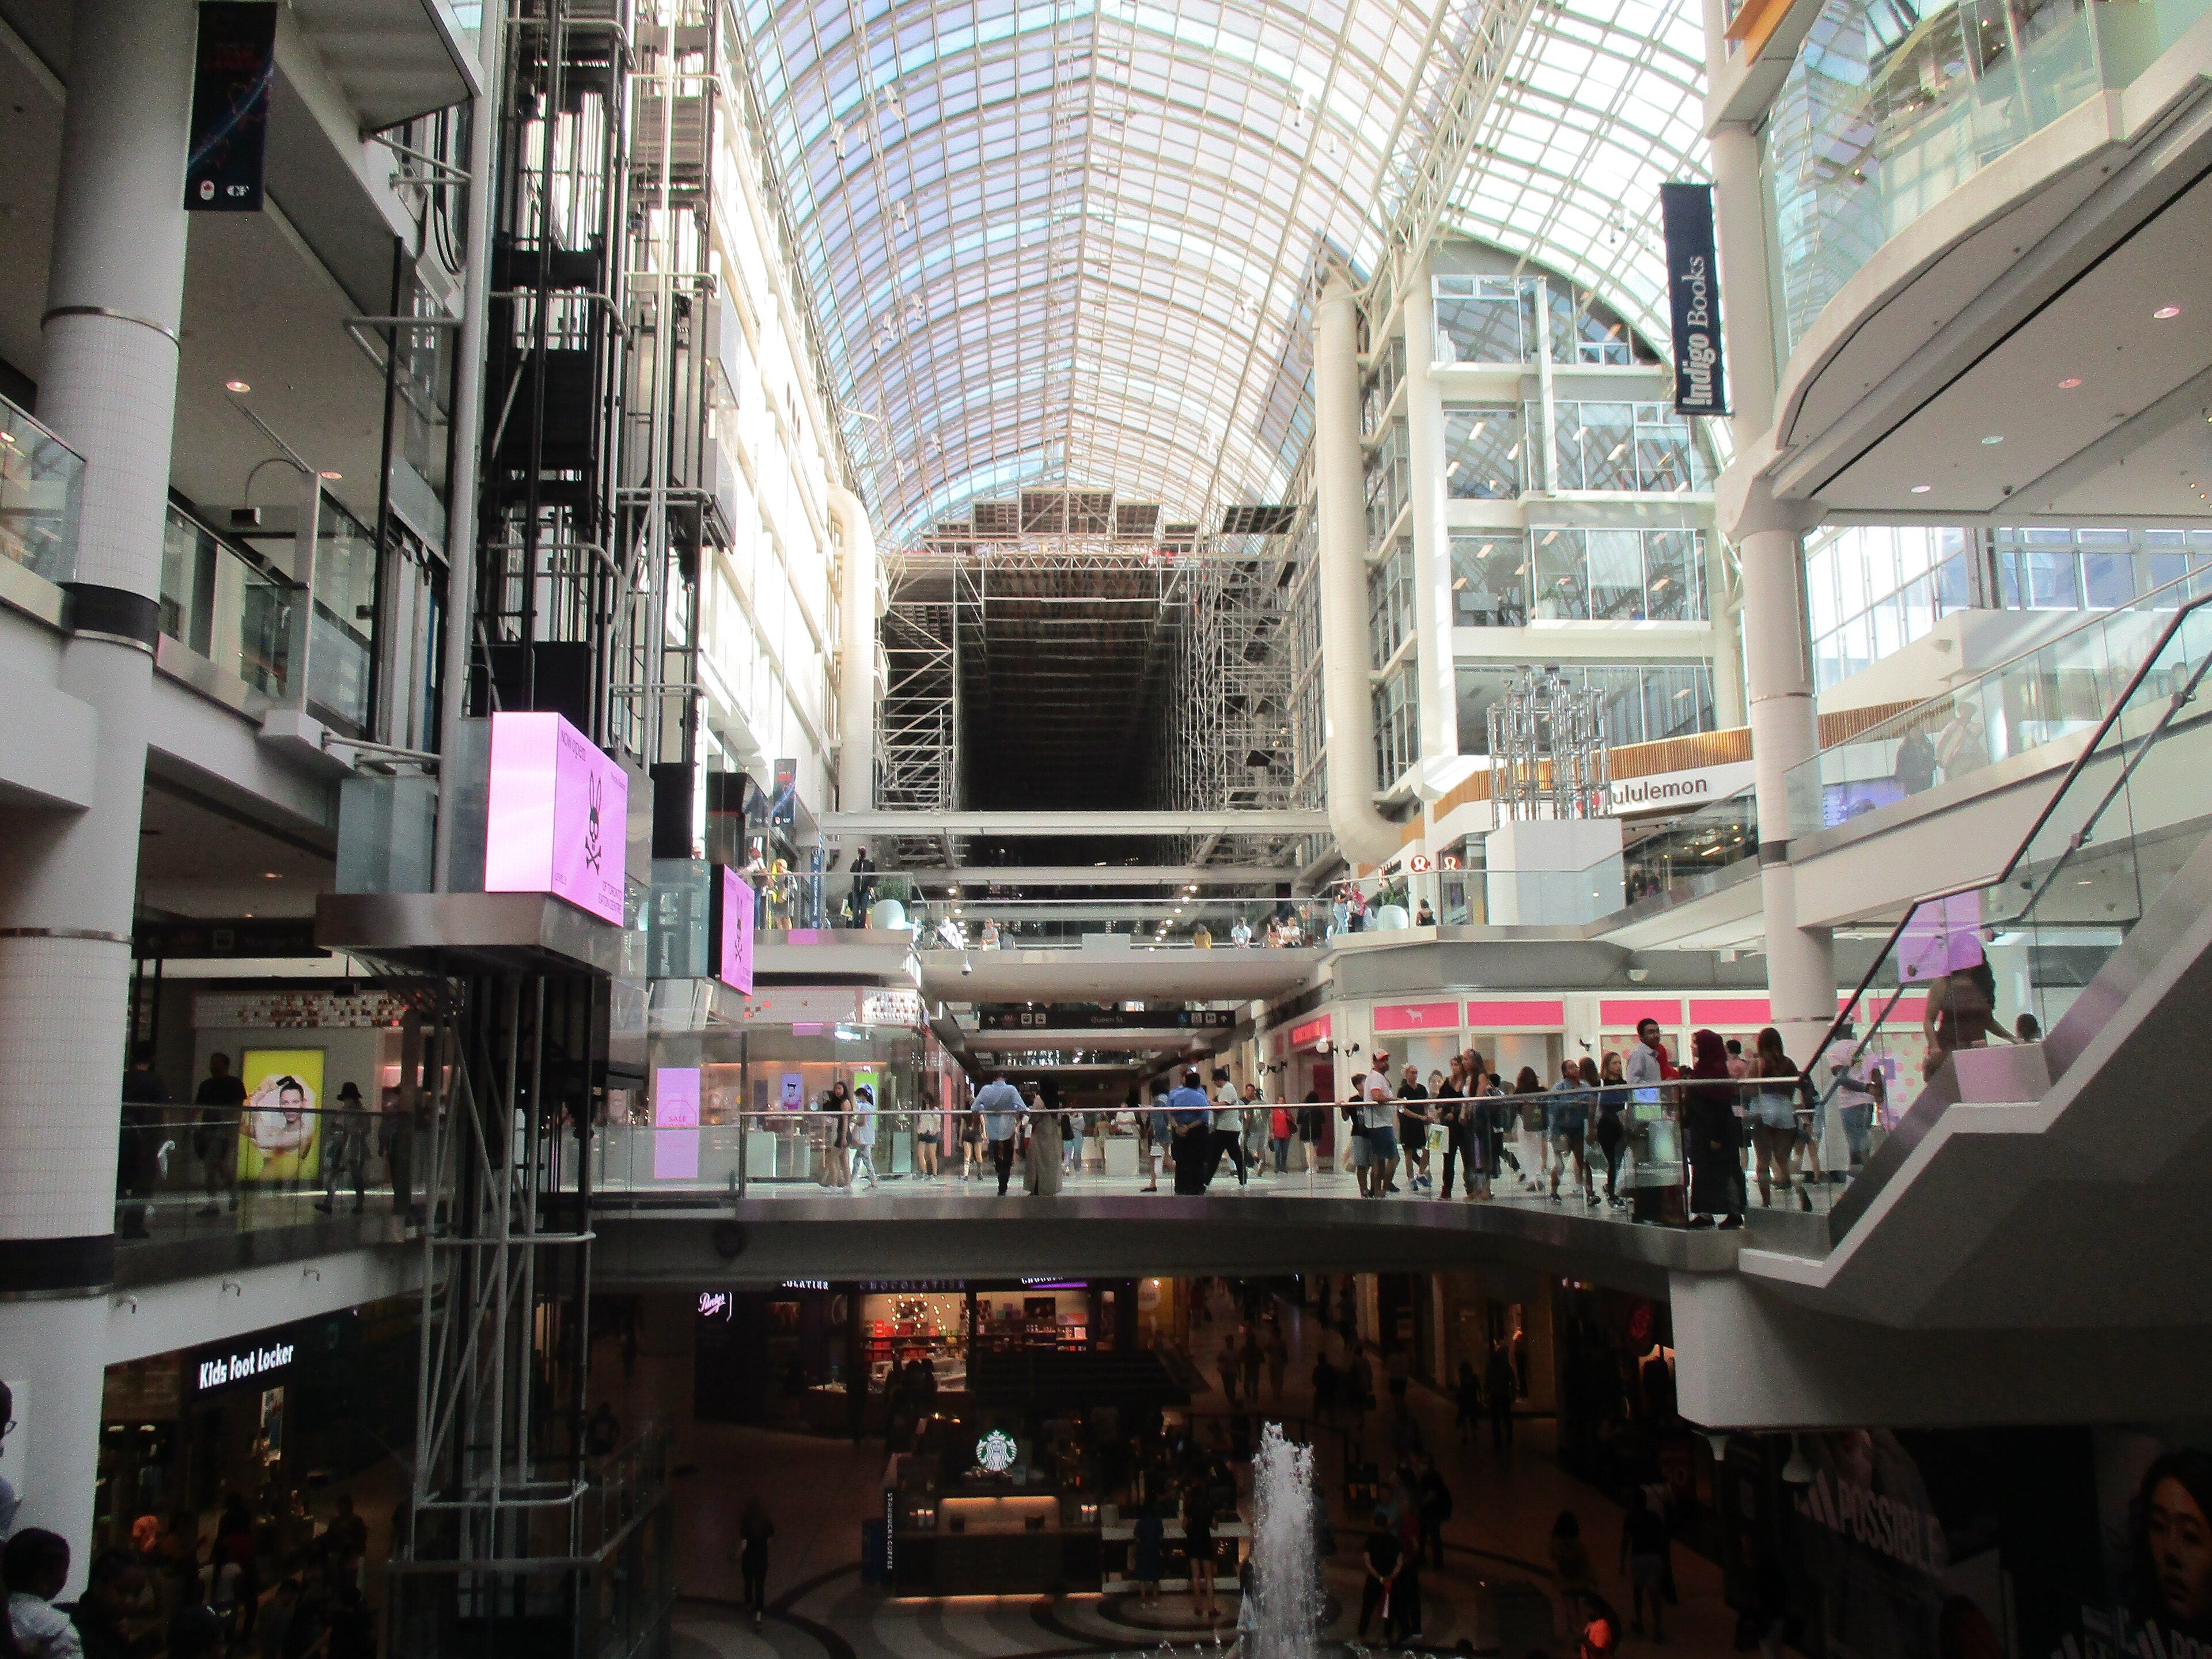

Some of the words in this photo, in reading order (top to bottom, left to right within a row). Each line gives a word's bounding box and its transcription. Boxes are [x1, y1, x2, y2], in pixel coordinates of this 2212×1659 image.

[1681, 255, 1709, 328] Books
[1610, 778, 1707, 804] ululemon
[199, 1359, 228, 1389] Kids
[229, 1351, 255, 1381] Foot
[257, 1343, 294, 1373] Locker
